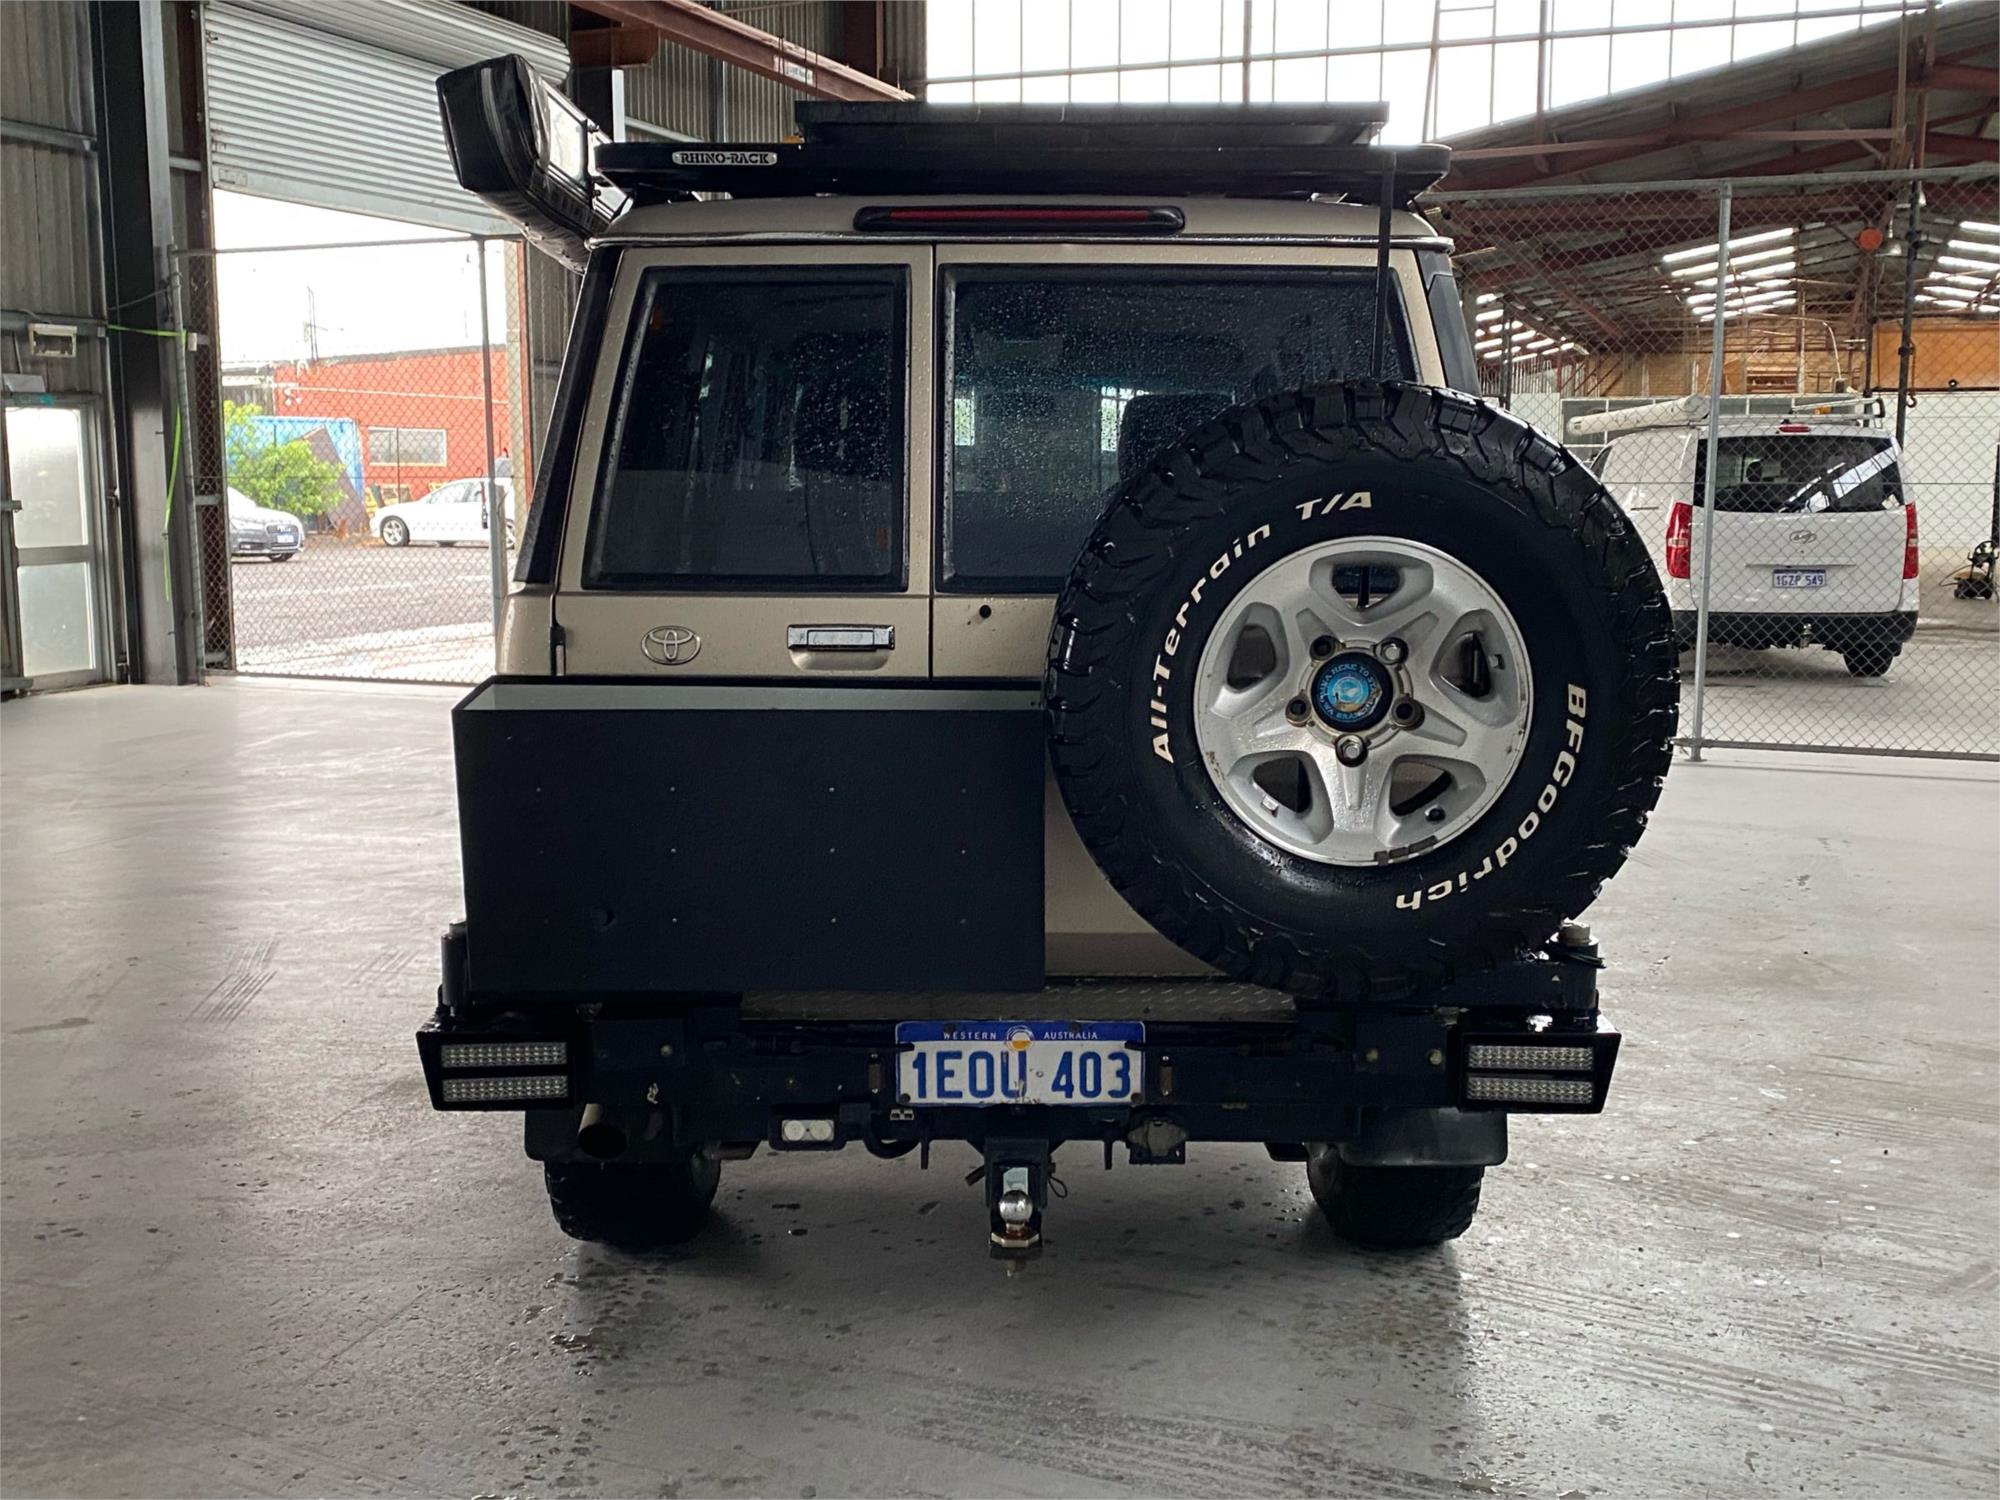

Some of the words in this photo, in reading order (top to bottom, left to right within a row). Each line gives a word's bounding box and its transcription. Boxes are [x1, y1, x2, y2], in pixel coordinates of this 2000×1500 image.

[680, 152, 769, 164] RHINO-RACK
[1150, 523, 1271, 763] All-Terrain
[1295, 491, 1372, 521] T/A
[1396, 683, 1587, 910] BFGoodrich
[943, 1031, 997, 1040] WESTERN
[1043, 1031, 1098, 1040] AUSTRALIA
[1051, 1051, 1131, 1099] 403
